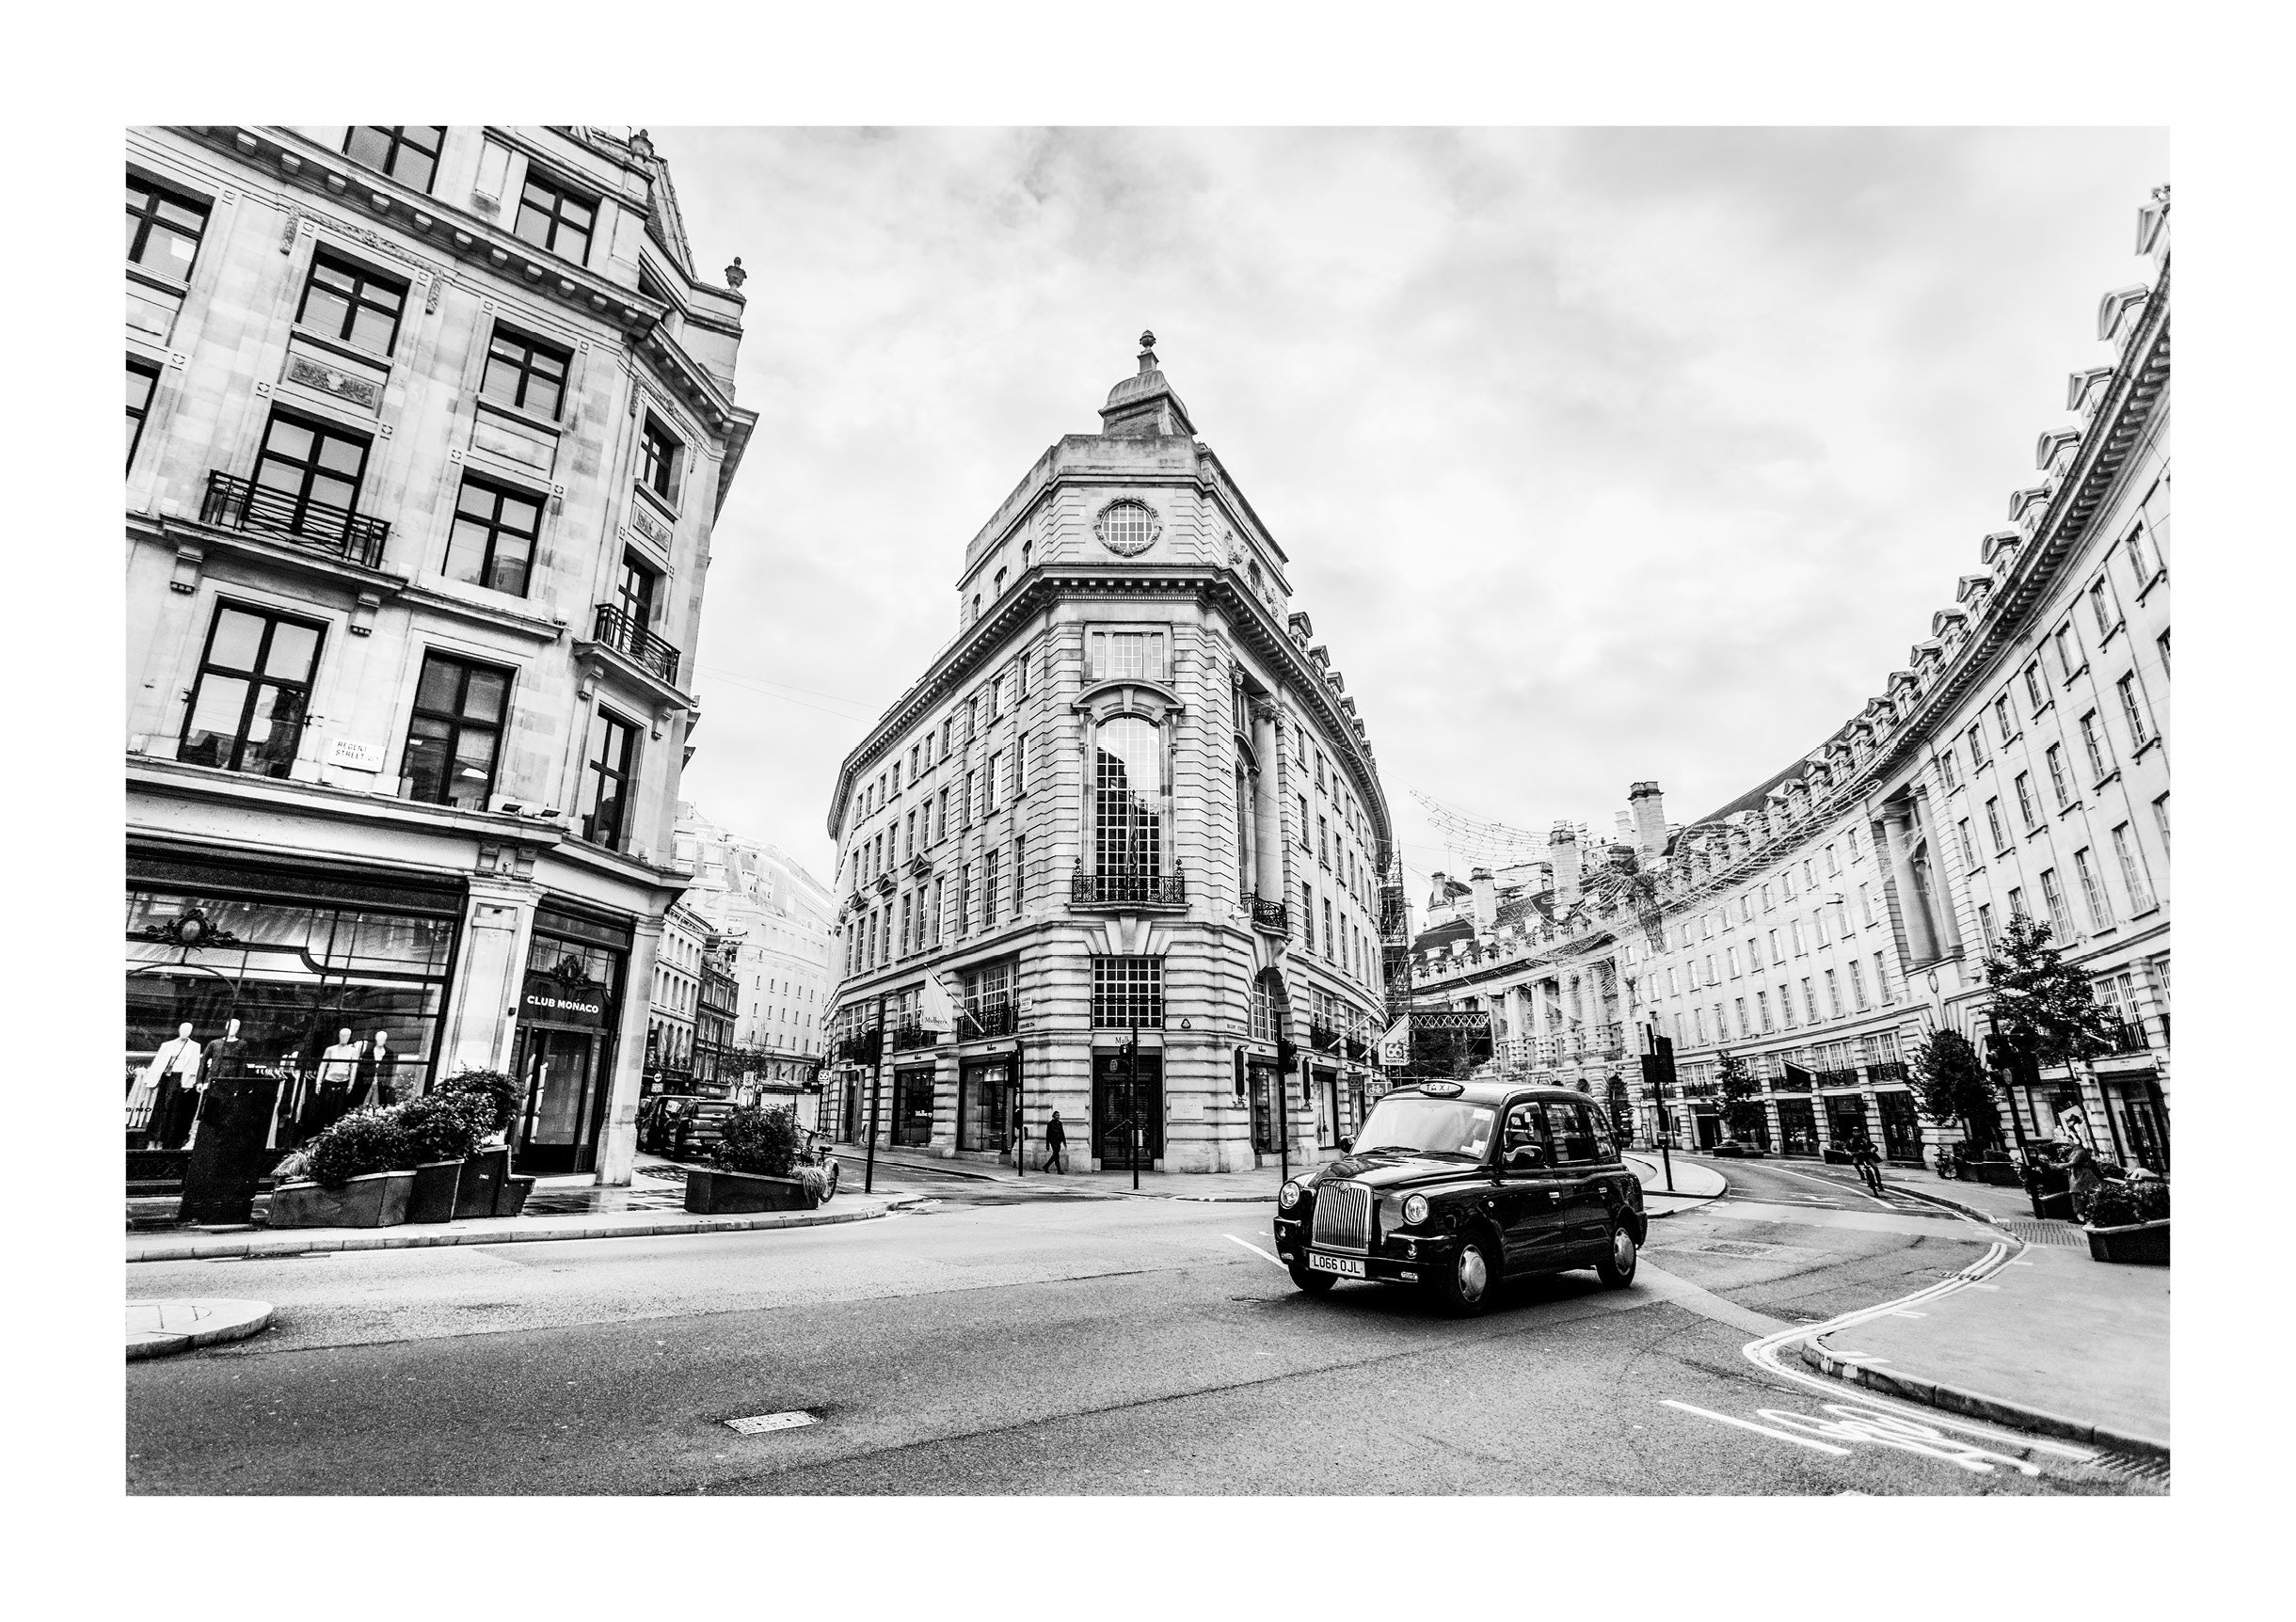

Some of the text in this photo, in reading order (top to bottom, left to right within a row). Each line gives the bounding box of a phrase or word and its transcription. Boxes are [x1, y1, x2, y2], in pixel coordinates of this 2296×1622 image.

[337, 740, 367, 753] REGENT
[335, 749, 365, 760] STREET
[526, 994, 599, 1014] CLUB MONACO
[1386, 1043, 1403, 1058] 66
[1426, 1084, 1451, 1092] TAXI
